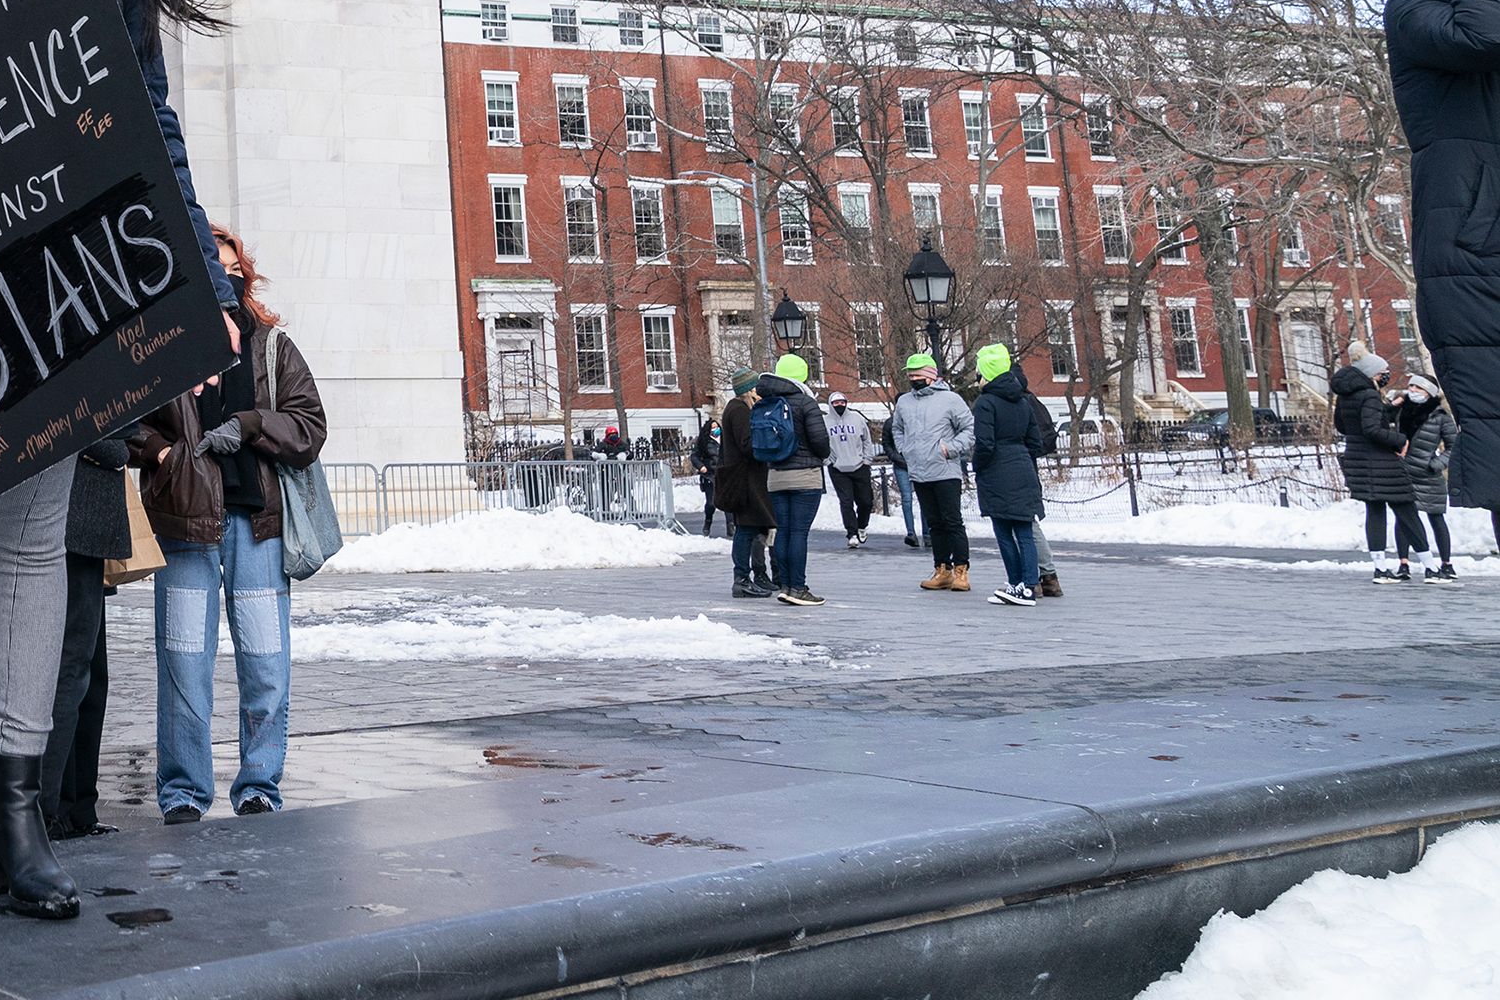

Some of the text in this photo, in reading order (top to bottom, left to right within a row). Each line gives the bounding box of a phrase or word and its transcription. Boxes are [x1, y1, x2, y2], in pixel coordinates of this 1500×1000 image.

[93, 112, 112, 139] LEE
[116, 314, 146, 351] Noel
[131, 325, 185, 365] Quintana
[74, 396, 92, 420] all
[830, 425, 855, 436] NYU
